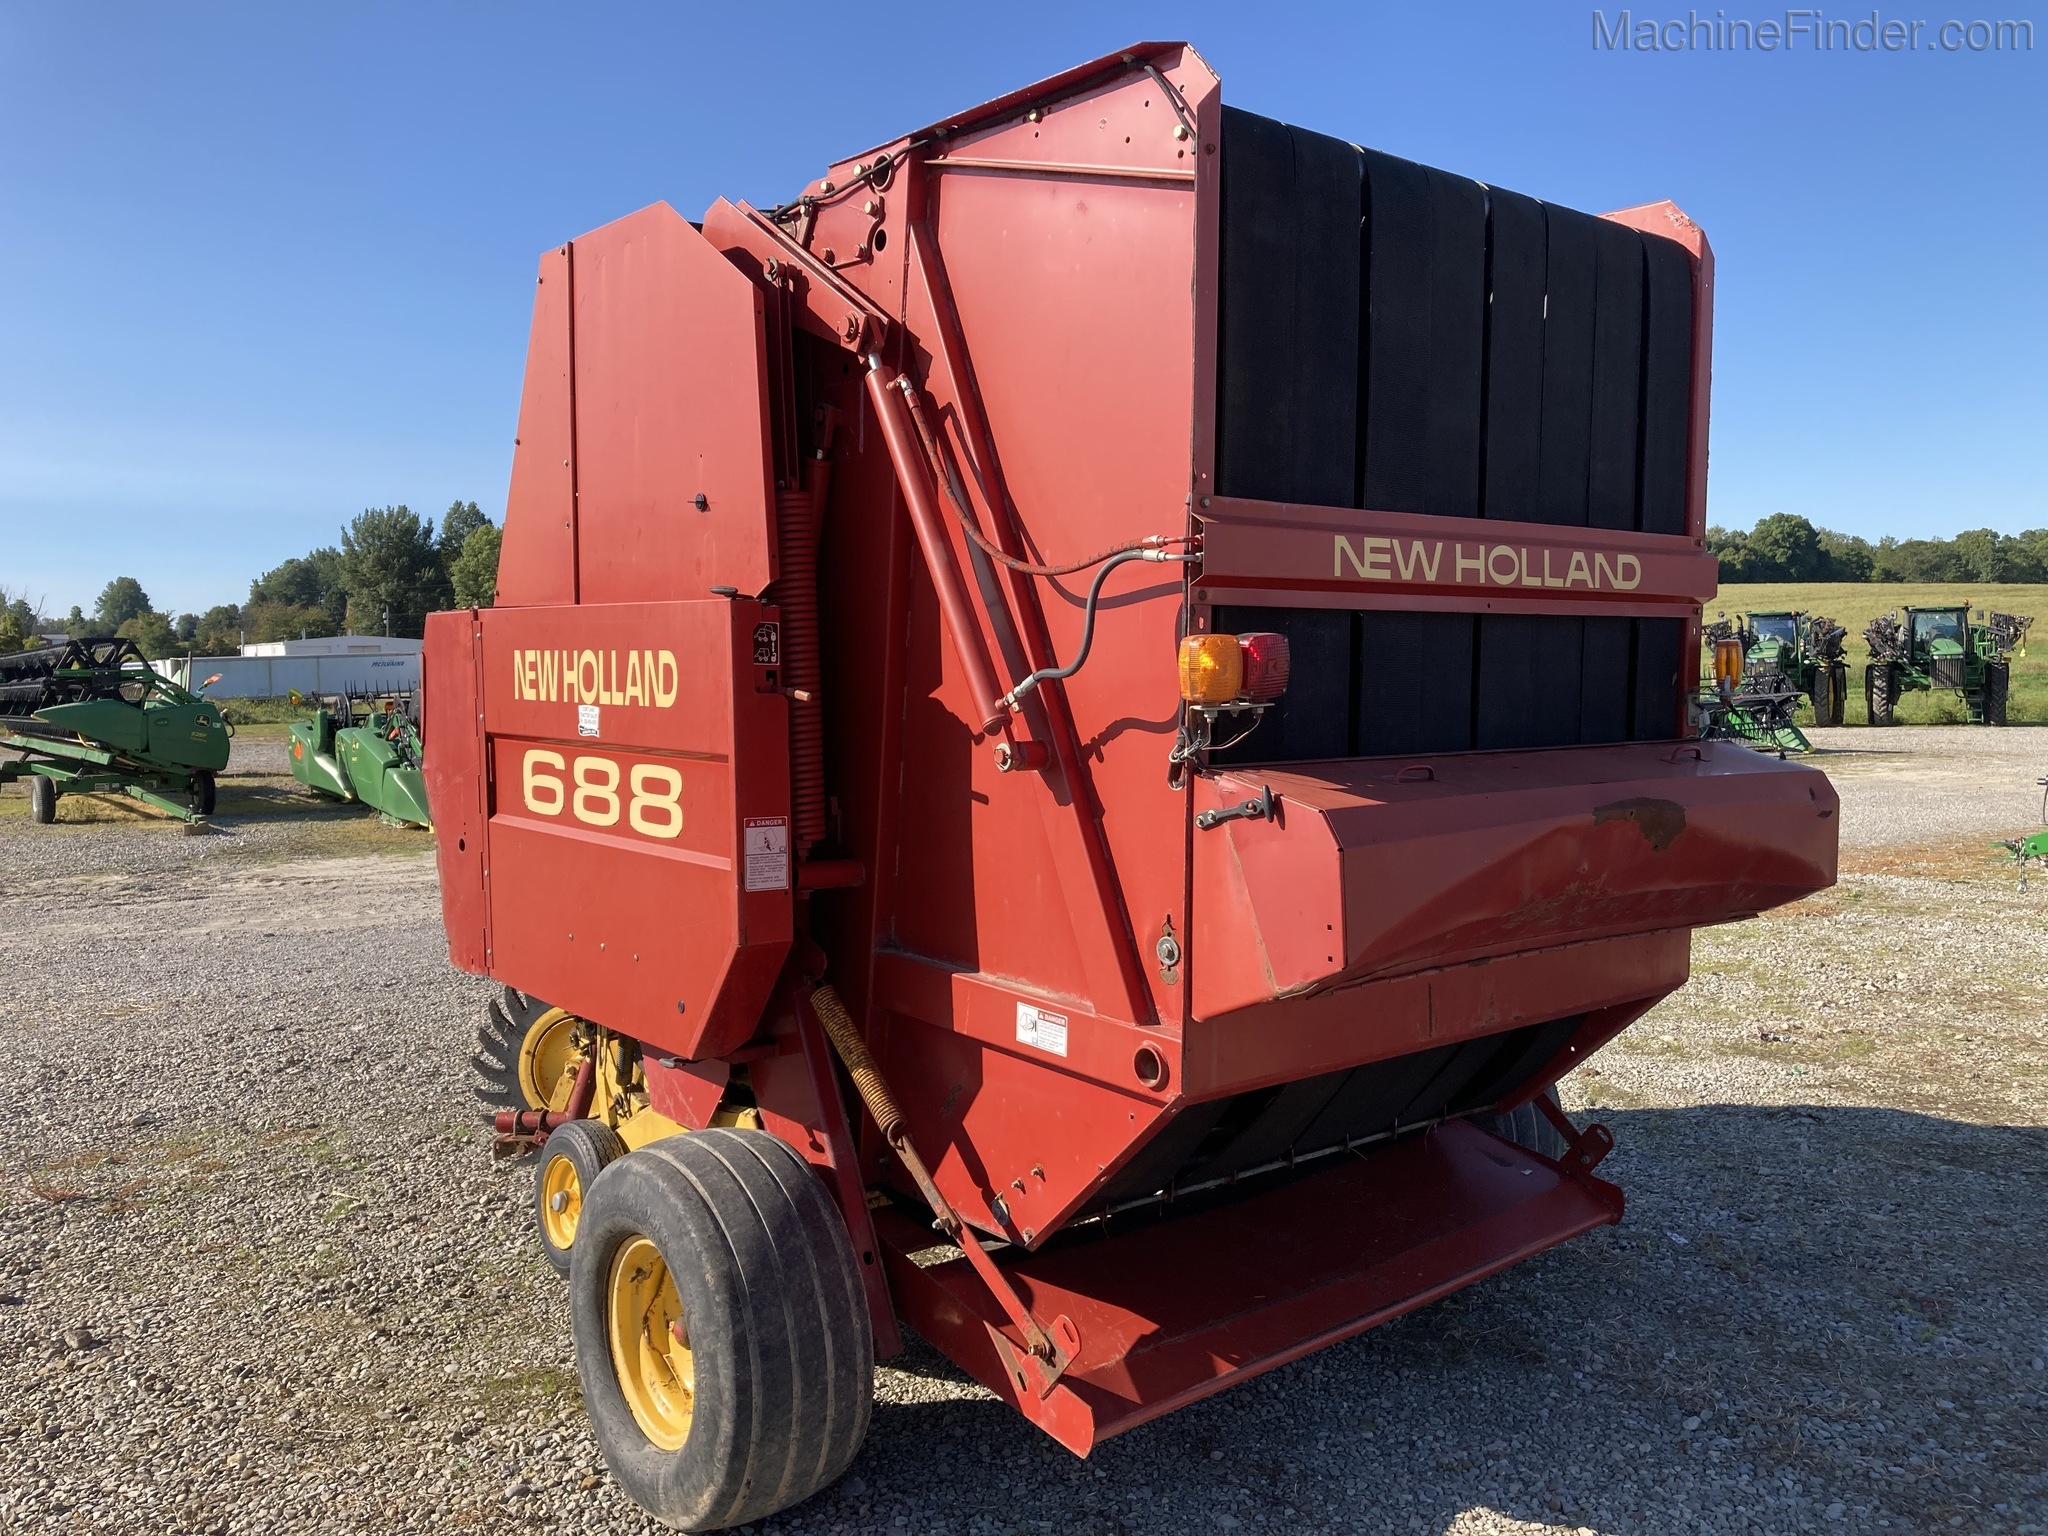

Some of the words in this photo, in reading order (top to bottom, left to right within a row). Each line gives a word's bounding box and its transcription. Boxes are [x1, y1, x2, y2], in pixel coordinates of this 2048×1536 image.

[1333, 535, 1443, 581] NEW
[1455, 543, 1642, 590] HOLLAND
[513, 649, 559, 702] NEW
[562, 649, 679, 708] HOLLAND
[523, 749, 684, 839] 688
[756, 819, 783, 827] DANGER
[1044, 1013, 1066, 1026] DANGER
